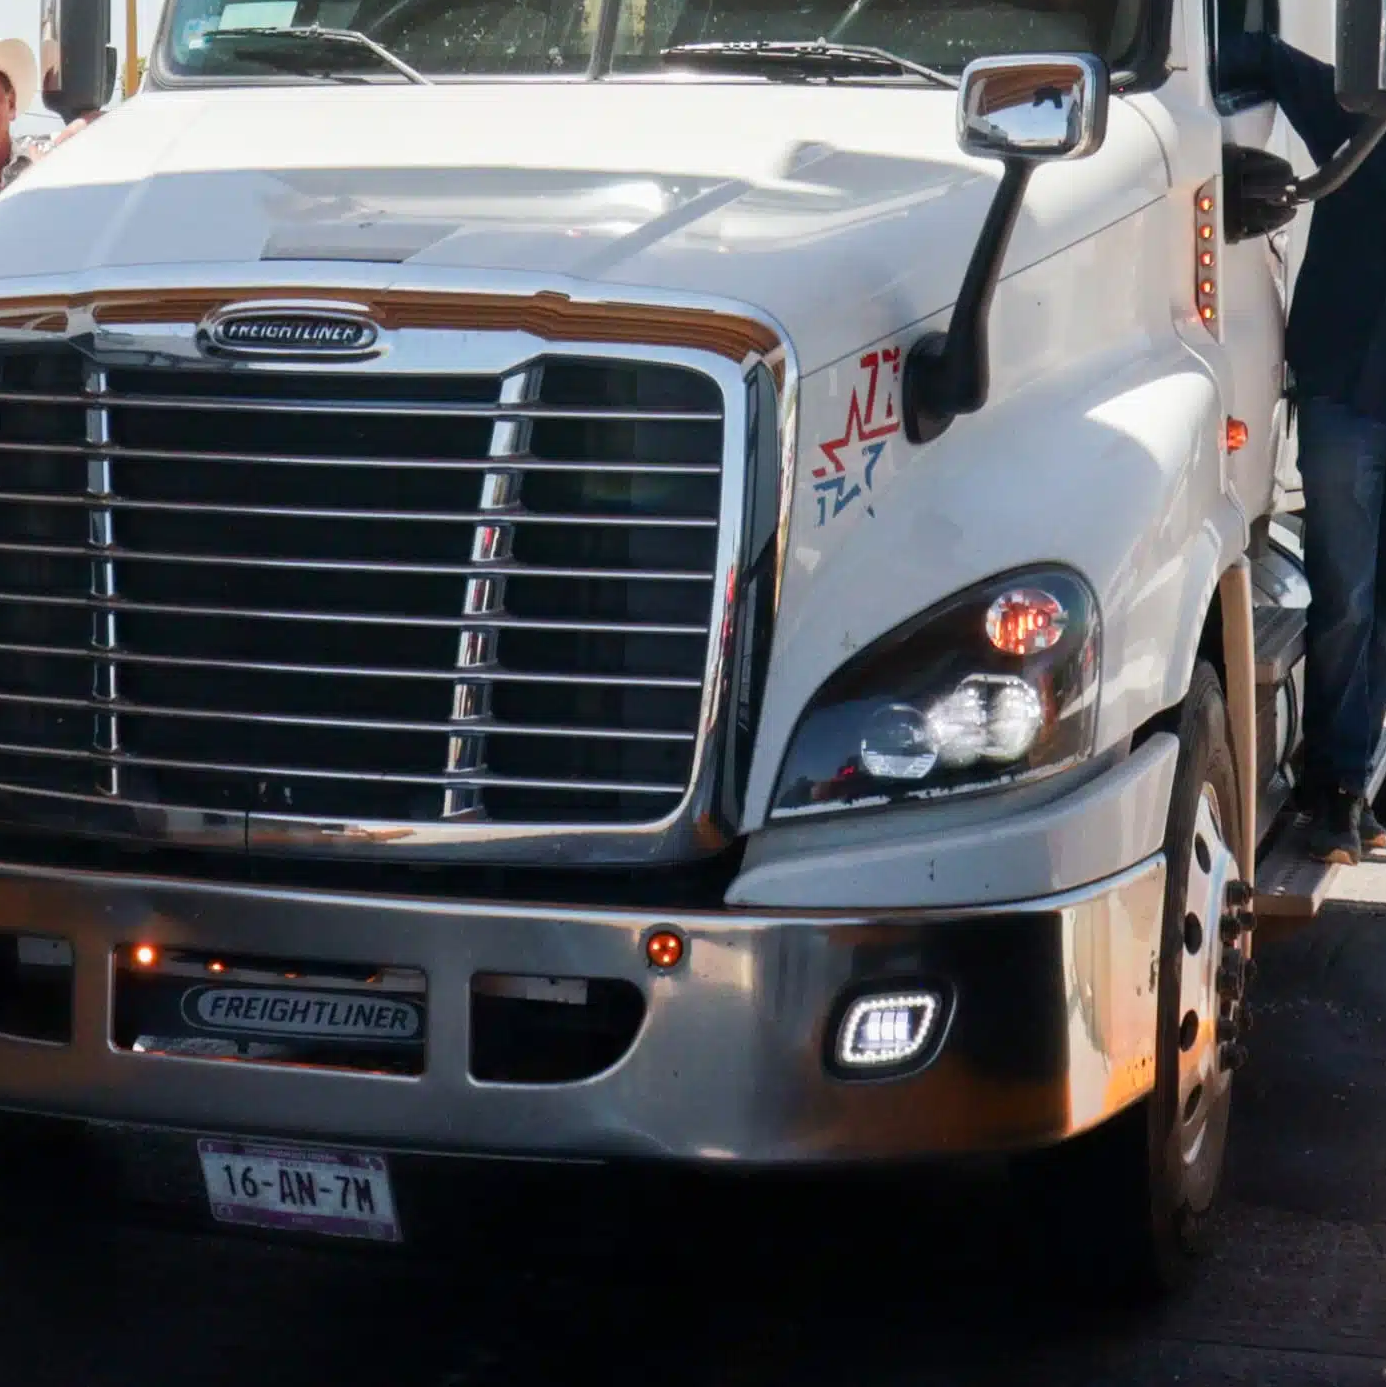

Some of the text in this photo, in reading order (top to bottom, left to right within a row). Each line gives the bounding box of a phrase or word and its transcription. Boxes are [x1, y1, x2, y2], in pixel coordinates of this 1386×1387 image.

[228, 320, 358, 341] FREIGHTLINER
[209, 995, 410, 1031] FREIGHTLINER
[222, 1163, 376, 1215] 16-AN-7M
